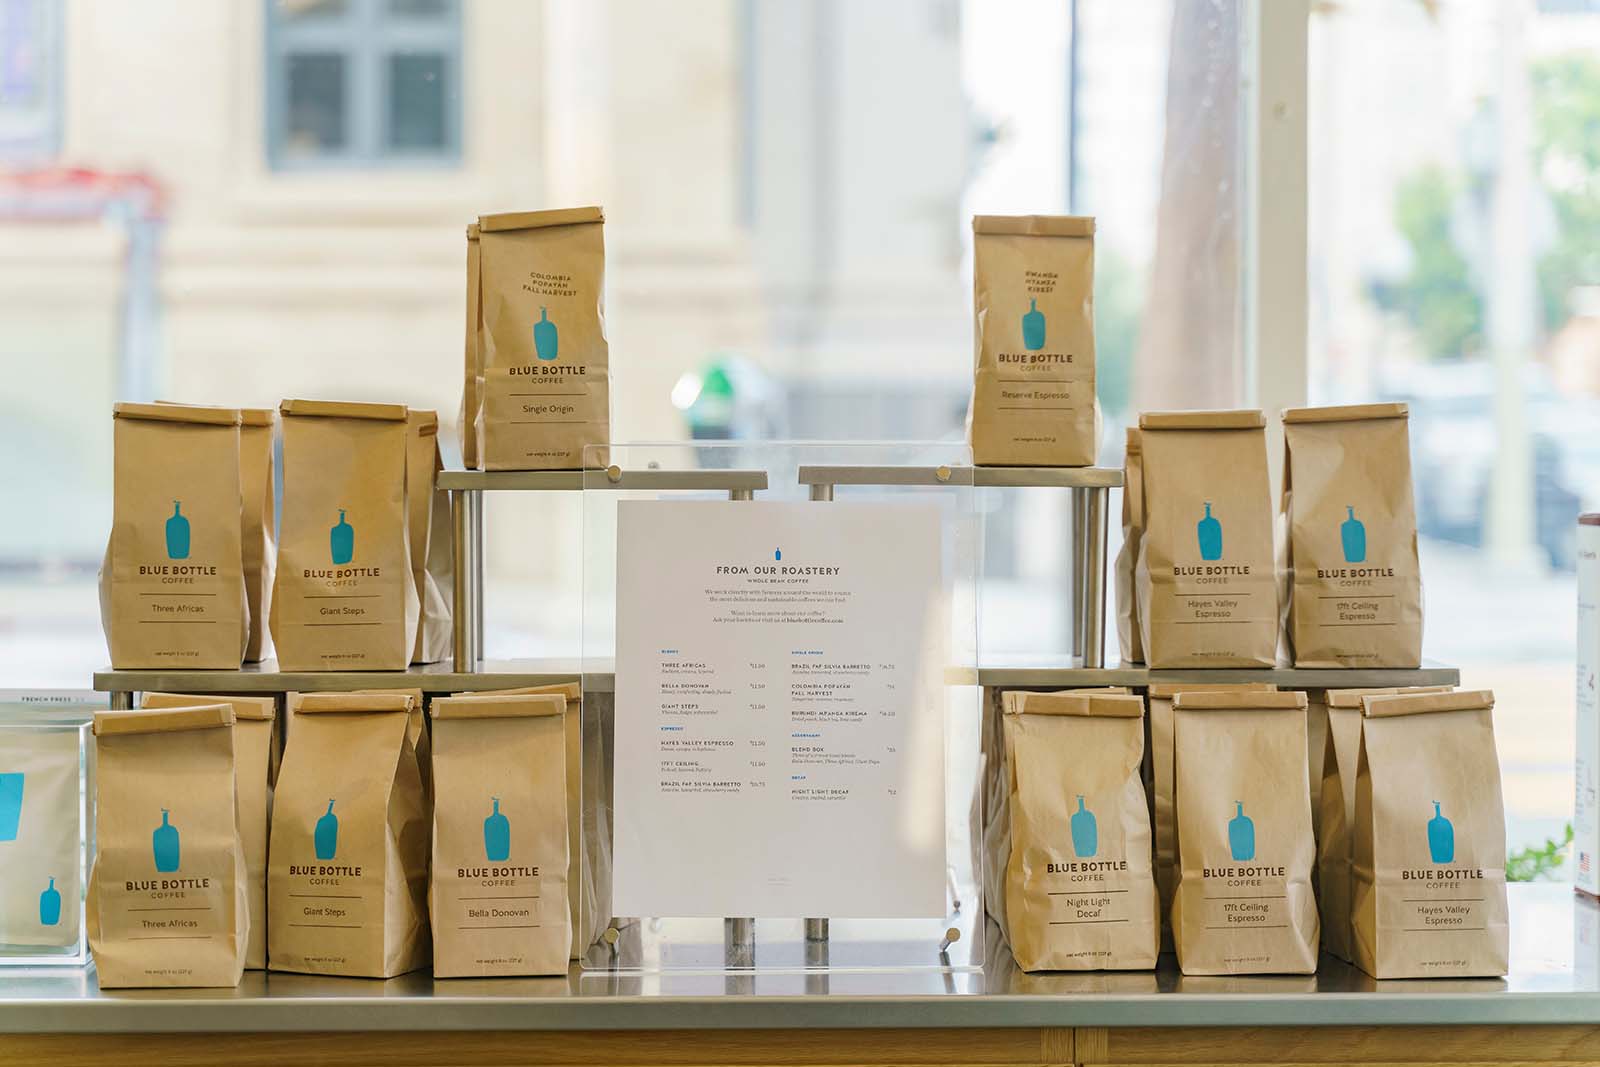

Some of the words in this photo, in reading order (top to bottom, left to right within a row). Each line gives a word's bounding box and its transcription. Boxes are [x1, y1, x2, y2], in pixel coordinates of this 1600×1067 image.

[530, 272, 571, 281] COLOMBIA
[523, 284, 540, 293] FALL
[999, 354, 1026, 363] BLUE
[1030, 354, 1072, 363] BOTTLE
[509, 367, 538, 376] BLUE
[542, 366, 585, 375] BOTTLE
[1002, 391, 1032, 399] Reserve
[1034, 392, 1069, 401] Espresso
[523, 405, 547, 414] Single
[550, 405, 574, 414] Origin
[140, 566, 168, 575] BLUE
[172, 566, 216, 575] BOTTLE
[304, 569, 333, 578] BLUE
[337, 568, 380, 578] BOTTLE
[716, 566, 748, 574] FROM
[754, 566, 776, 574] OUR
[782, 567, 840, 575] ROASTERY
[1174, 567, 1203, 575] BLUE
[1206, 566, 1250, 575] BOTTLE
[1317, 570, 1347, 578] BLUE
[1350, 568, 1394, 577] BOTTLE
[152, 604, 174, 612] Three
[177, 605, 204, 613] Africas
[1214, 600, 1238, 608] Valley
[1352, 602, 1378, 611] Ceiling
[1195, 610, 1231, 618] Espresso
[290, 866, 316, 875] BLUE
[320, 866, 362, 876] BOTTLE
[1048, 864, 1078, 873] BLUE
[1081, 861, 1126, 871] BOTTLE
[458, 869, 488, 878] BLUE
[493, 867, 539, 877] BOTTLE
[1203, 869, 1234, 878] BLUE
[1238, 867, 1285, 876] BOTTLE
[1403, 870, 1433, 880] BLUE
[1437, 870, 1483, 879] BOTTLE
[1071, 874, 1104, 882] COFFEE
[126, 881, 158, 891] BLUE
[162, 879, 209, 889] BOTTLE
[1067, 899, 1089, 908] Night
[1091, 898, 1111, 906] Light
[304, 908, 323, 916] Giant
[325, 908, 346, 917] Steps
[1240, 904, 1269, 912] Ceiling
[1417, 906, 1442, 915] Hayes
[1445, 906, 1470, 914] Valley
[492, 909, 529, 917] Donovan
[1077, 910, 1101, 918] Decaf
[1228, 914, 1265, 923] Espresso
[1425, 917, 1462, 925] Espresso
[142, 920, 166, 928] Three
[169, 920, 198, 928] Africas
